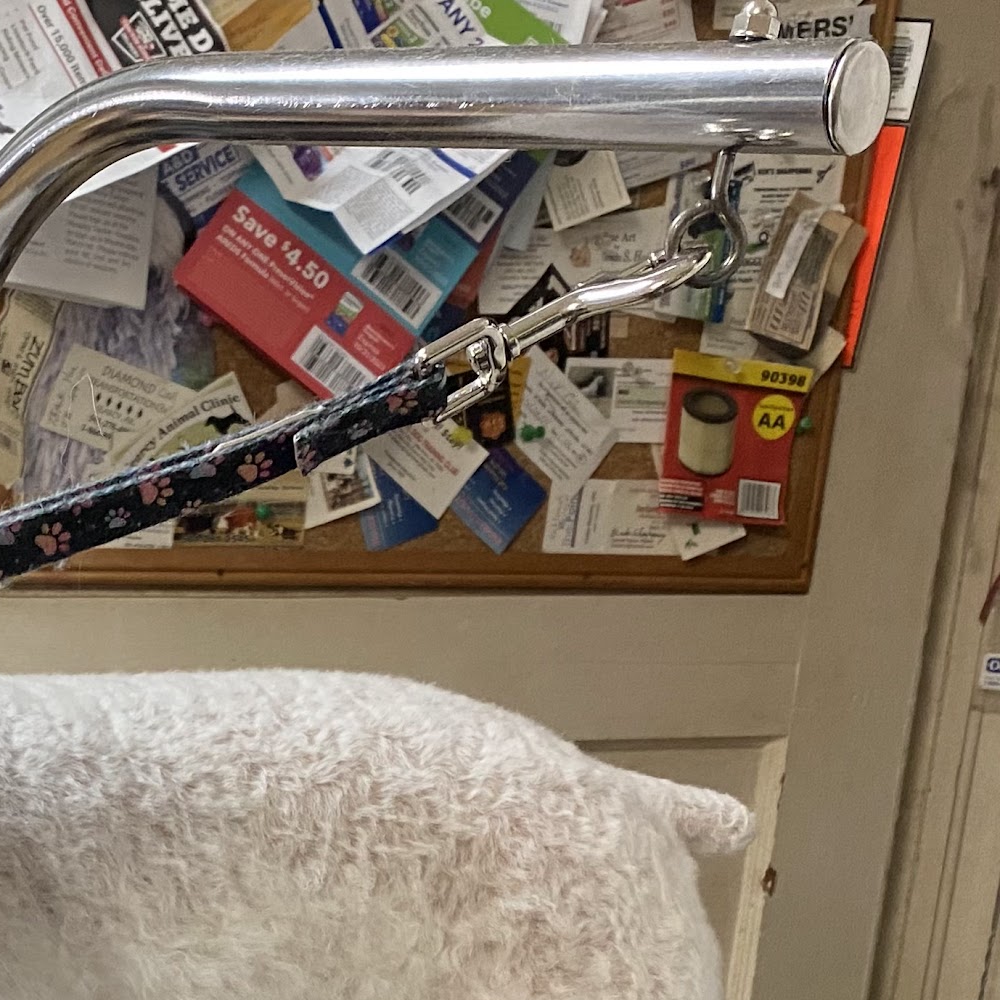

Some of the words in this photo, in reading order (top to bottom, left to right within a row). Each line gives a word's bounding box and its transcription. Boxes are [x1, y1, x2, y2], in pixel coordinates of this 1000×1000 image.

[36, 3, 54, 29] Over
[49, 28, 75, 64] 15,000
[173, 144, 235, 191] SERVICE
[230, 203, 279, 249] Save
[275, 239, 332, 291] $4.50
[101, 364, 157, 395] DIAMOND
[760, 370, 808, 388] 90398
[156, 406, 200, 438] Animal
[198, 392, 241, 412] Clinic
[757, 412, 786, 430] AA
